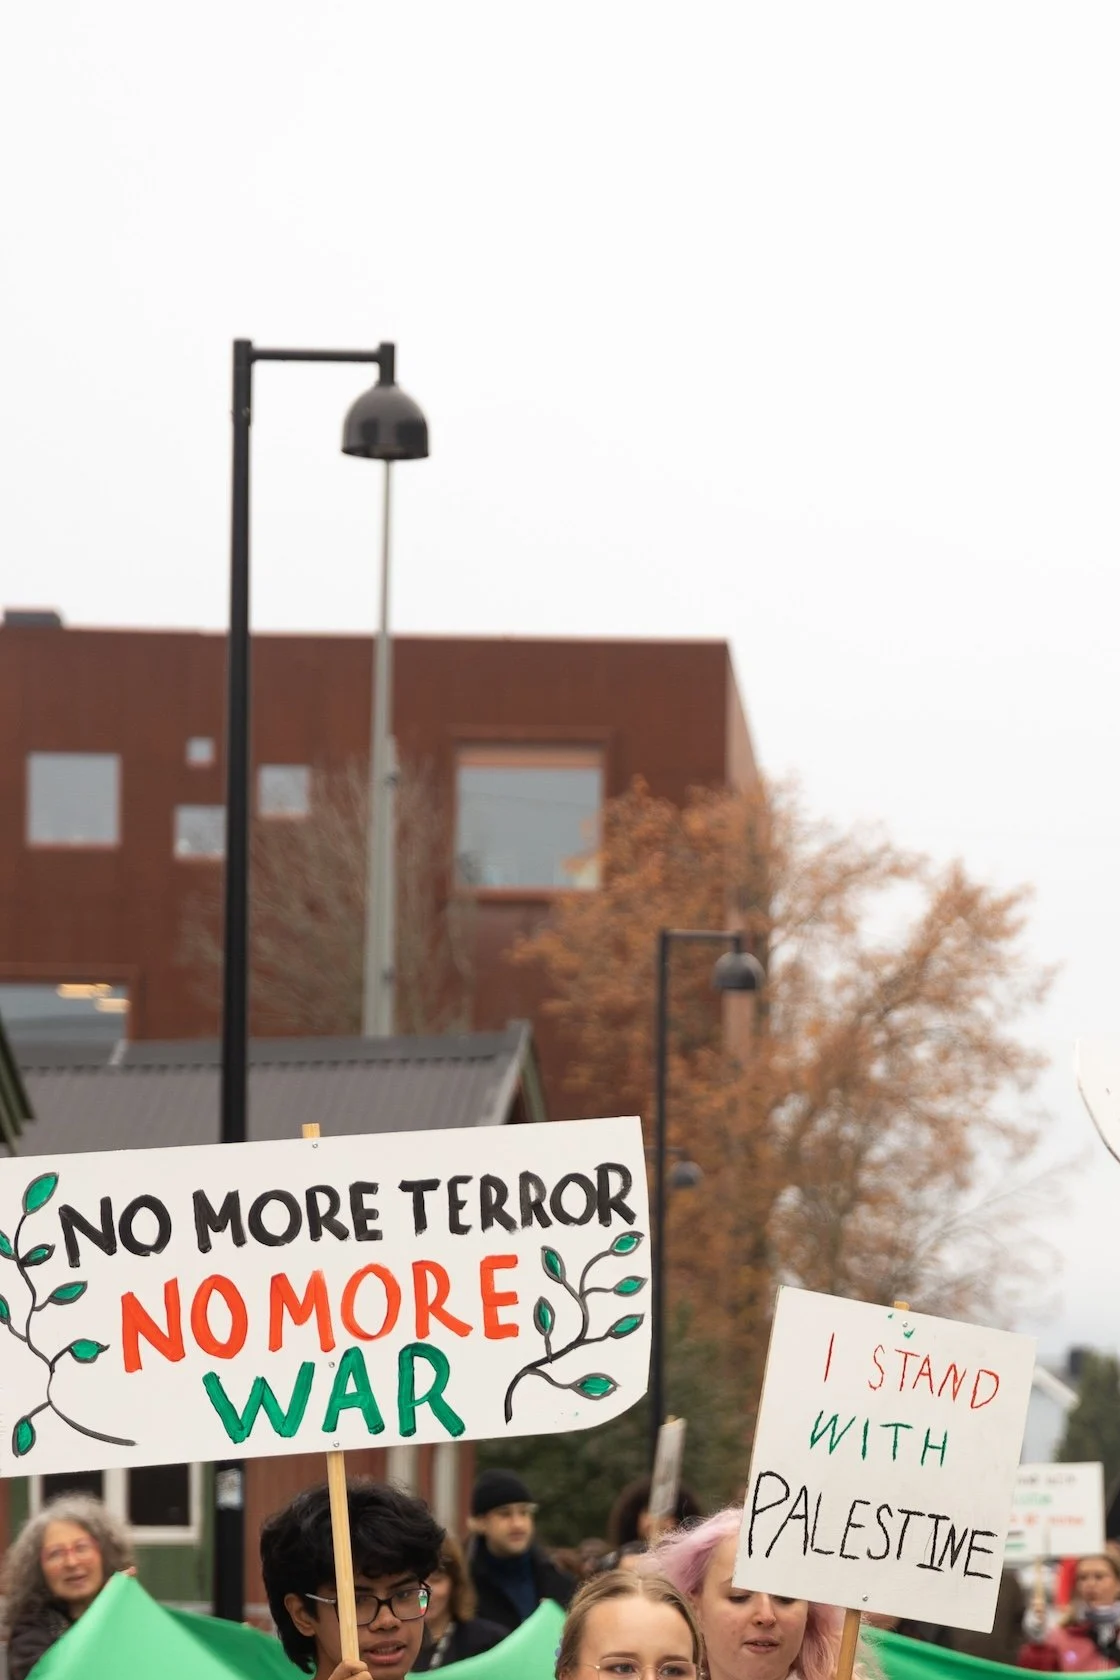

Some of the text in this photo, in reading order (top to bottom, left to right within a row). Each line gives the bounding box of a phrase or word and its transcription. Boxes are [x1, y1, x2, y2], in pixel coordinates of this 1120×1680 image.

[58, 1162, 638, 1268] NO MORE TERROR
[120, 1254, 519, 1373] NO MORE
[201, 1342, 466, 1444] WAR
[824, 1332, 1000, 1410] I STAND
[810, 1410, 949, 1467] WITH
[748, 1470, 998, 1580] PALESTINE
